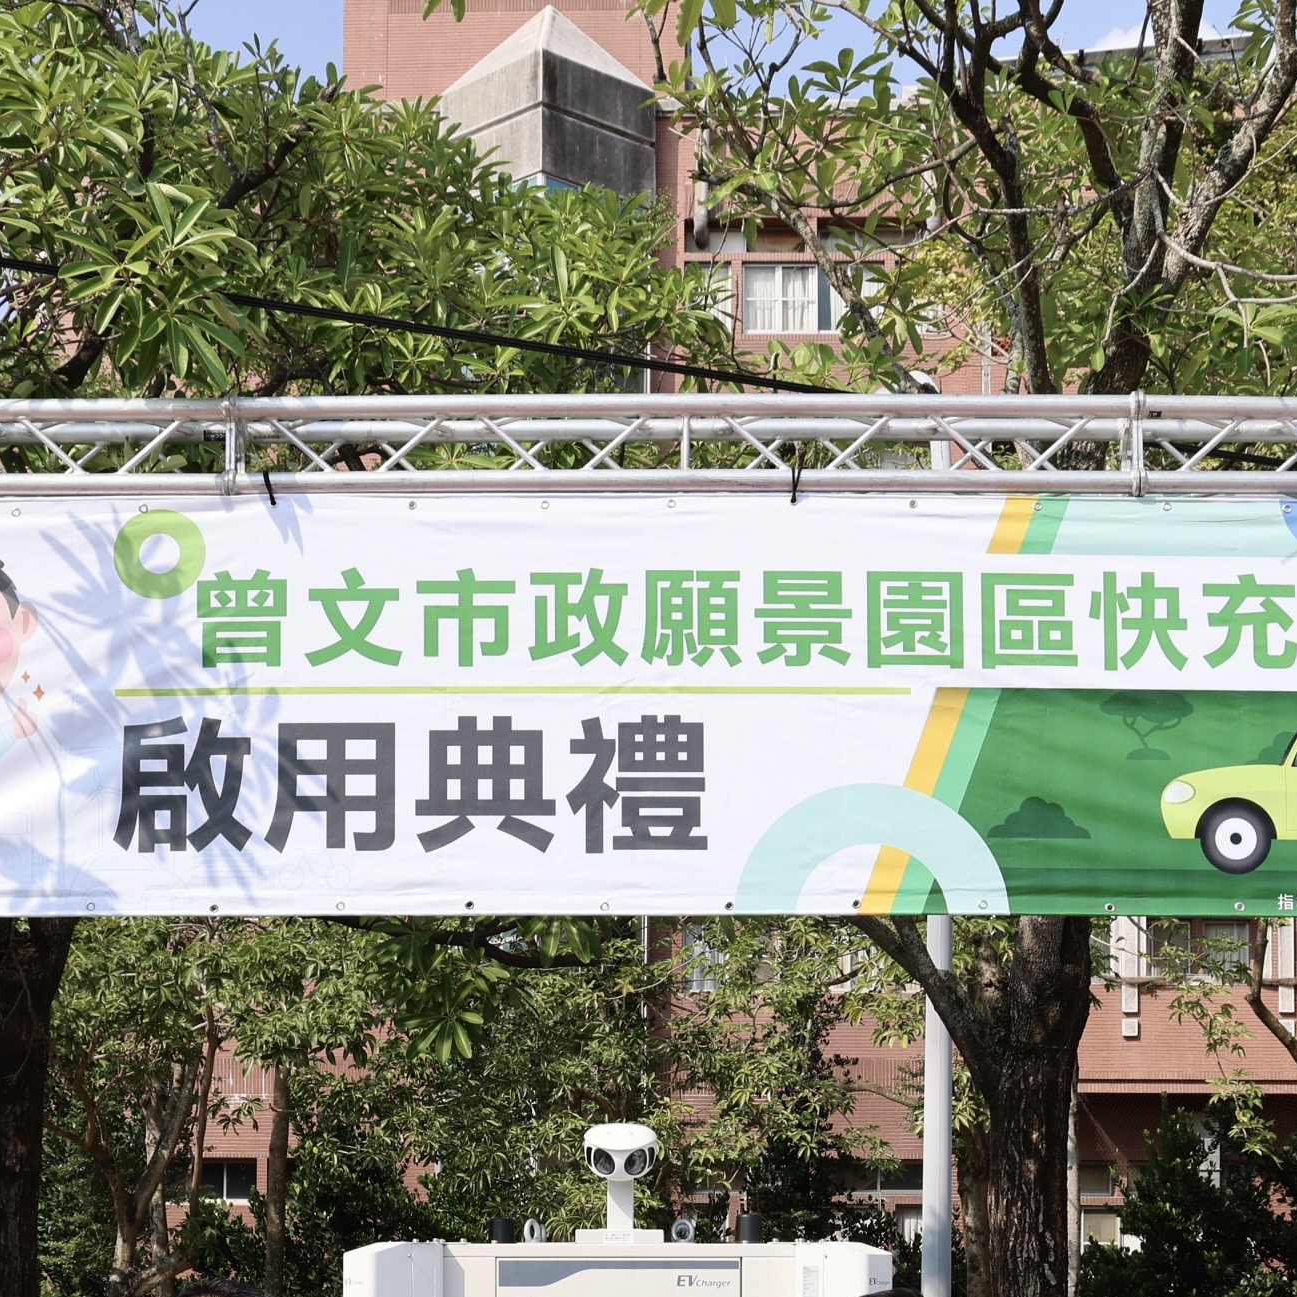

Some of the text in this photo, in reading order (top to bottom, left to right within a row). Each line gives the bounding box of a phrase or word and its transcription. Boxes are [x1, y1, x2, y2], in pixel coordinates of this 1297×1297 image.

[113, 714, 709, 856] 啟用典禮
[696, 1278, 731, 1289] Charger
